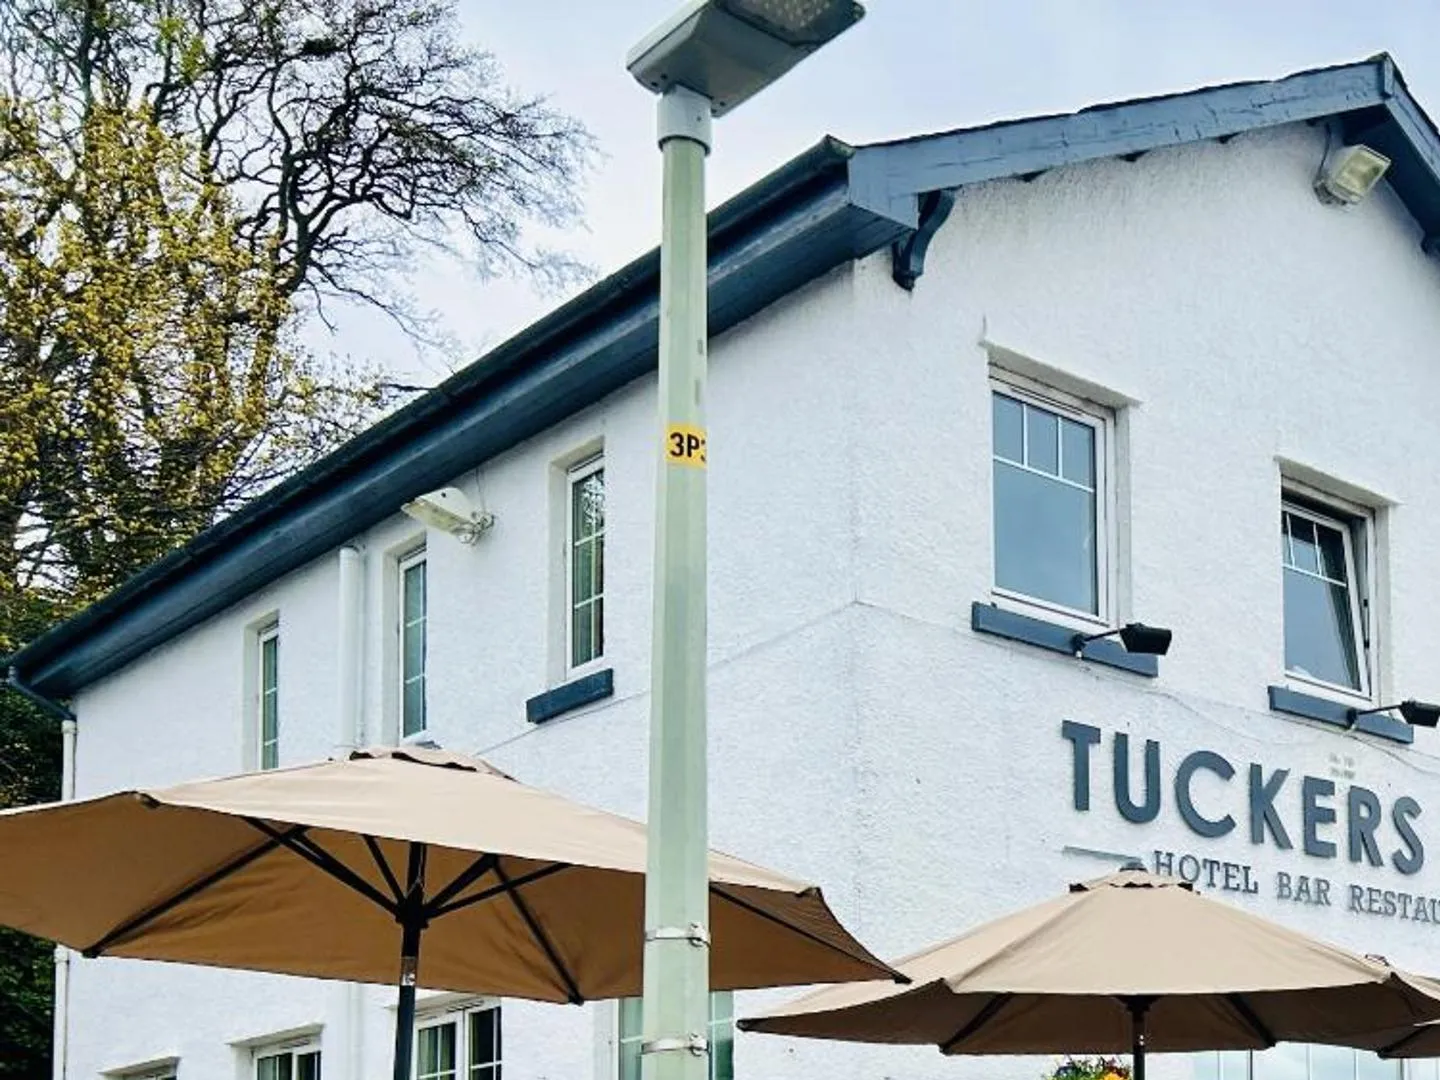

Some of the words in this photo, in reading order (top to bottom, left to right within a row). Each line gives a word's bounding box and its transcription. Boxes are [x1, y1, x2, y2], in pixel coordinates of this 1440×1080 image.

[1061, 719, 1425, 876] TUCKERS
[1153, 850, 1259, 895] HOTEL
[1276, 871, 1331, 906] BAR
